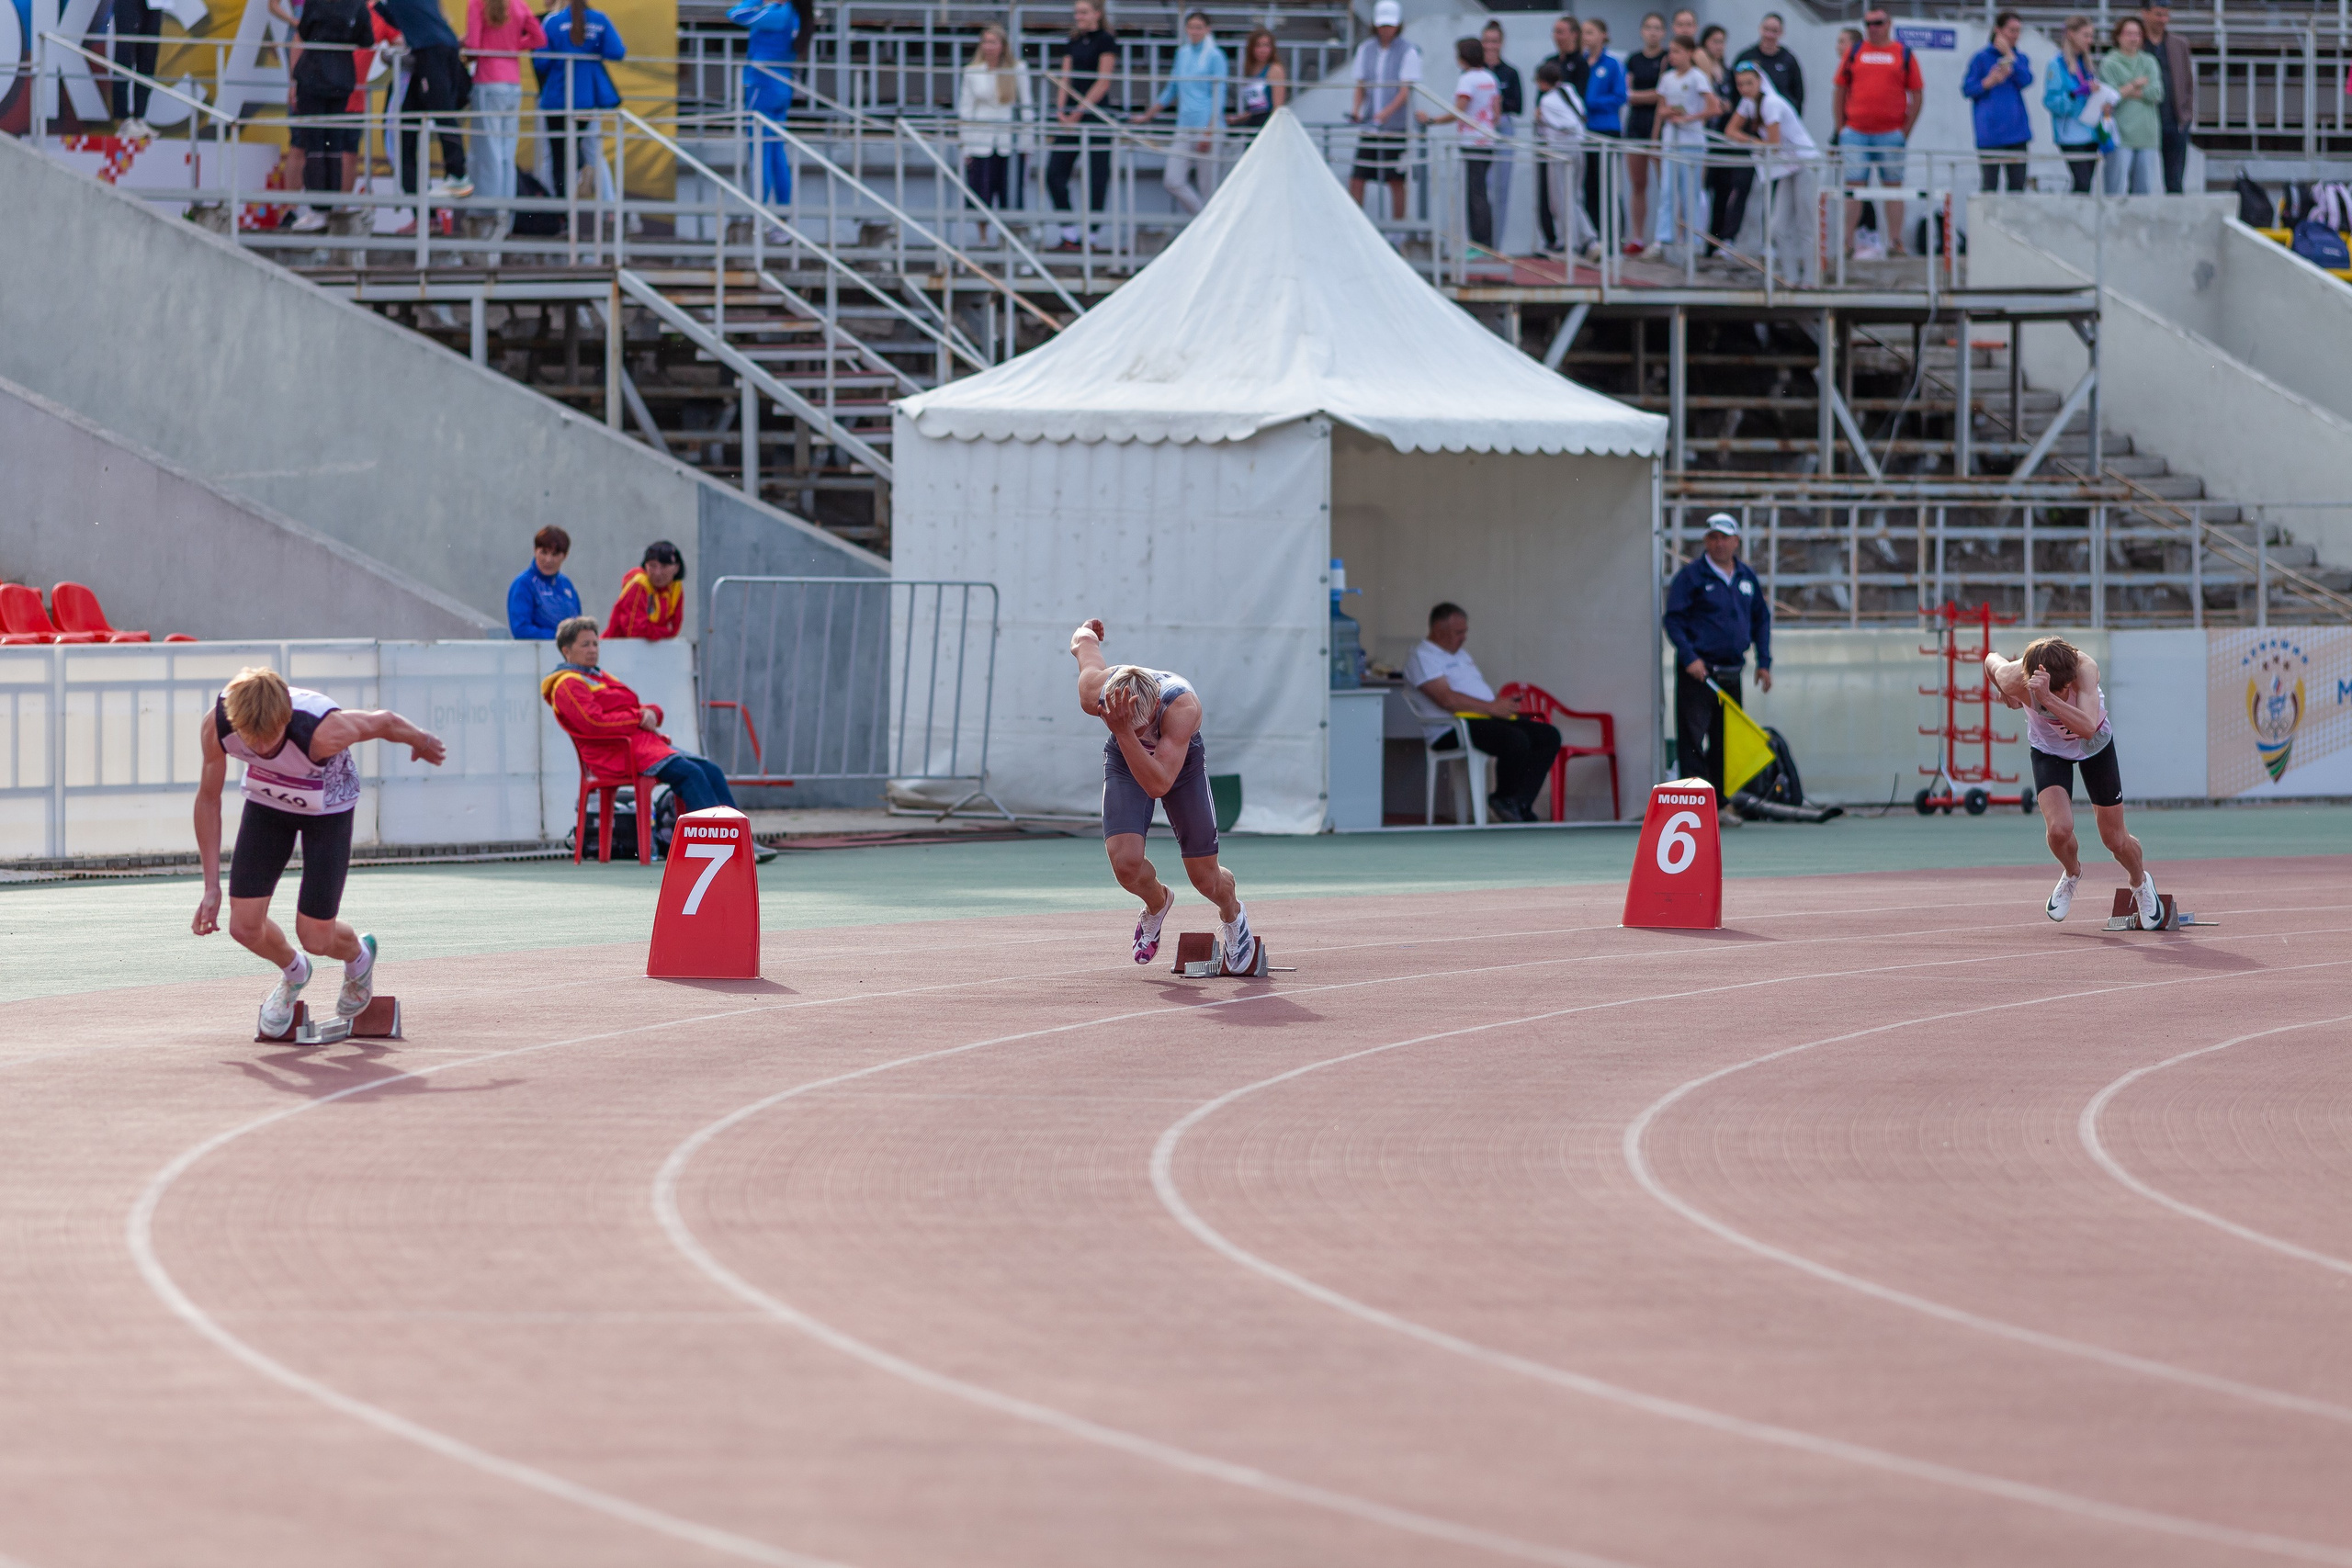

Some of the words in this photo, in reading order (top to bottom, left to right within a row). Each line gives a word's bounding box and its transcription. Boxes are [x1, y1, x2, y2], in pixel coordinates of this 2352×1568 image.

[1657, 794, 1706, 806] MONDO
[684, 827, 740, 839] MONDO
[1657, 810, 1702, 874] 6
[682, 843, 736, 916] 7
